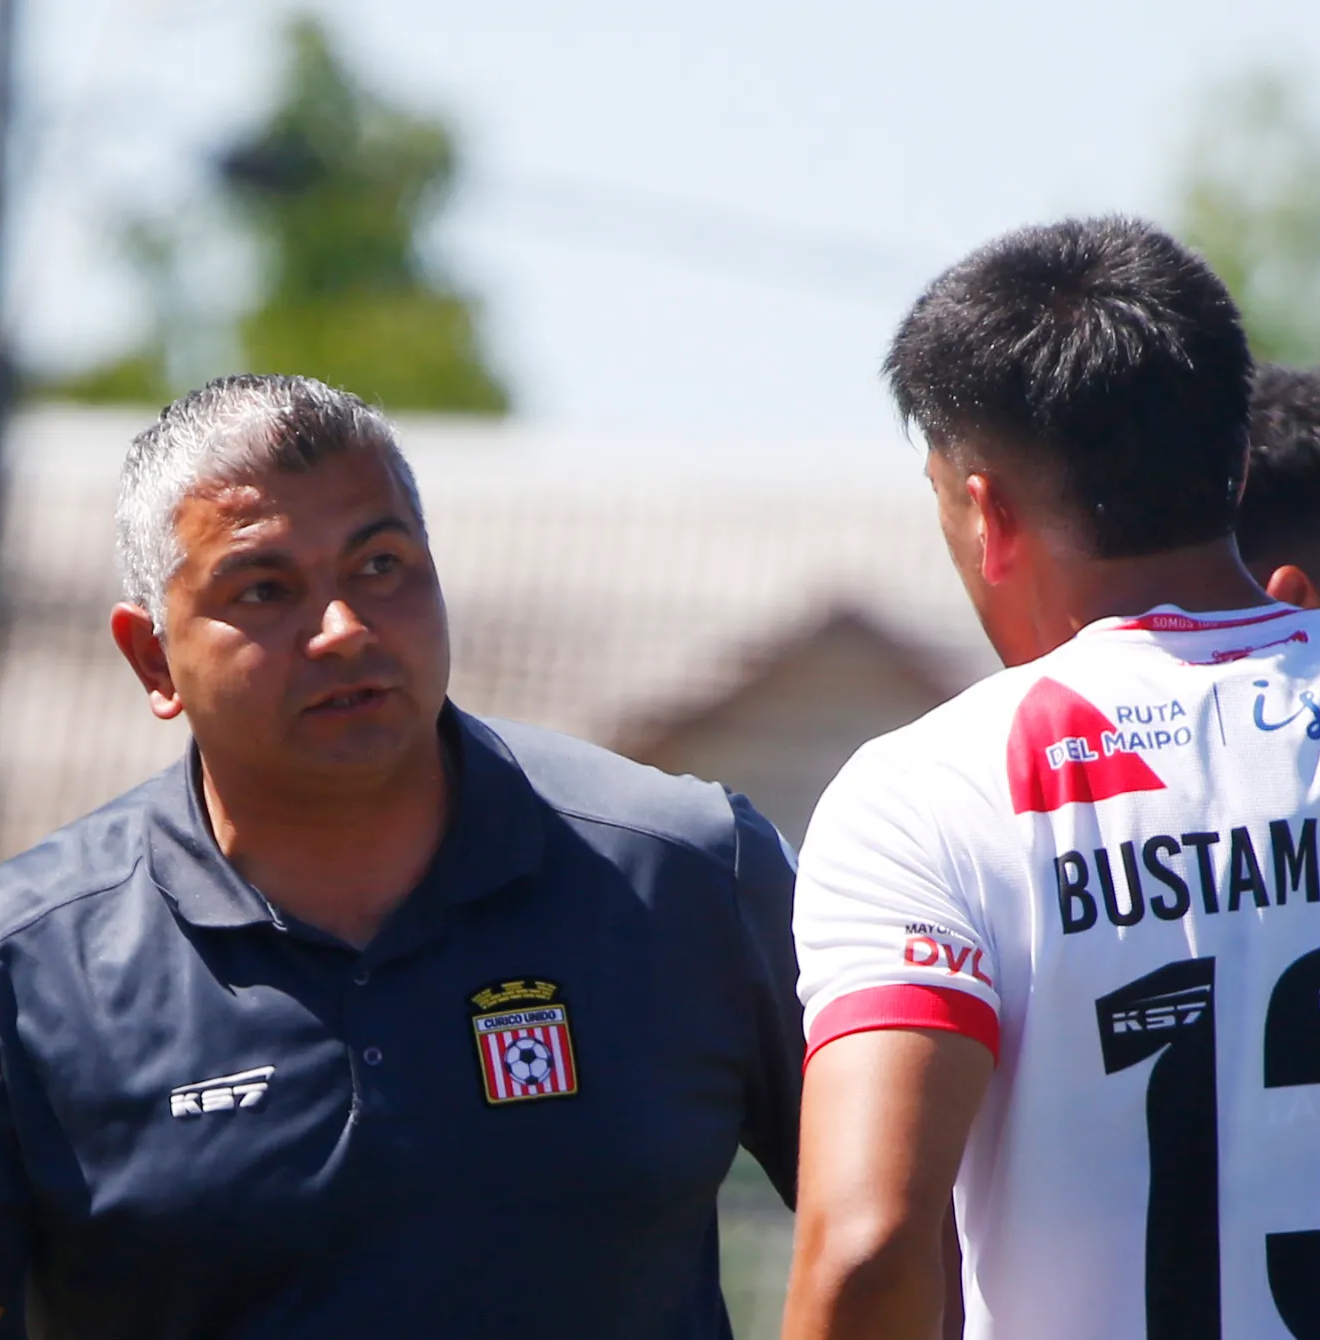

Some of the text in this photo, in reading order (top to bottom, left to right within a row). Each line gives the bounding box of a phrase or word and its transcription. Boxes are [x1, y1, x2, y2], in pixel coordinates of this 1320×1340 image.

[1115, 700, 1187, 725] RUTA
[1047, 726, 1192, 768] DEL MAIPO
[1111, 1001, 1208, 1034] KS7
